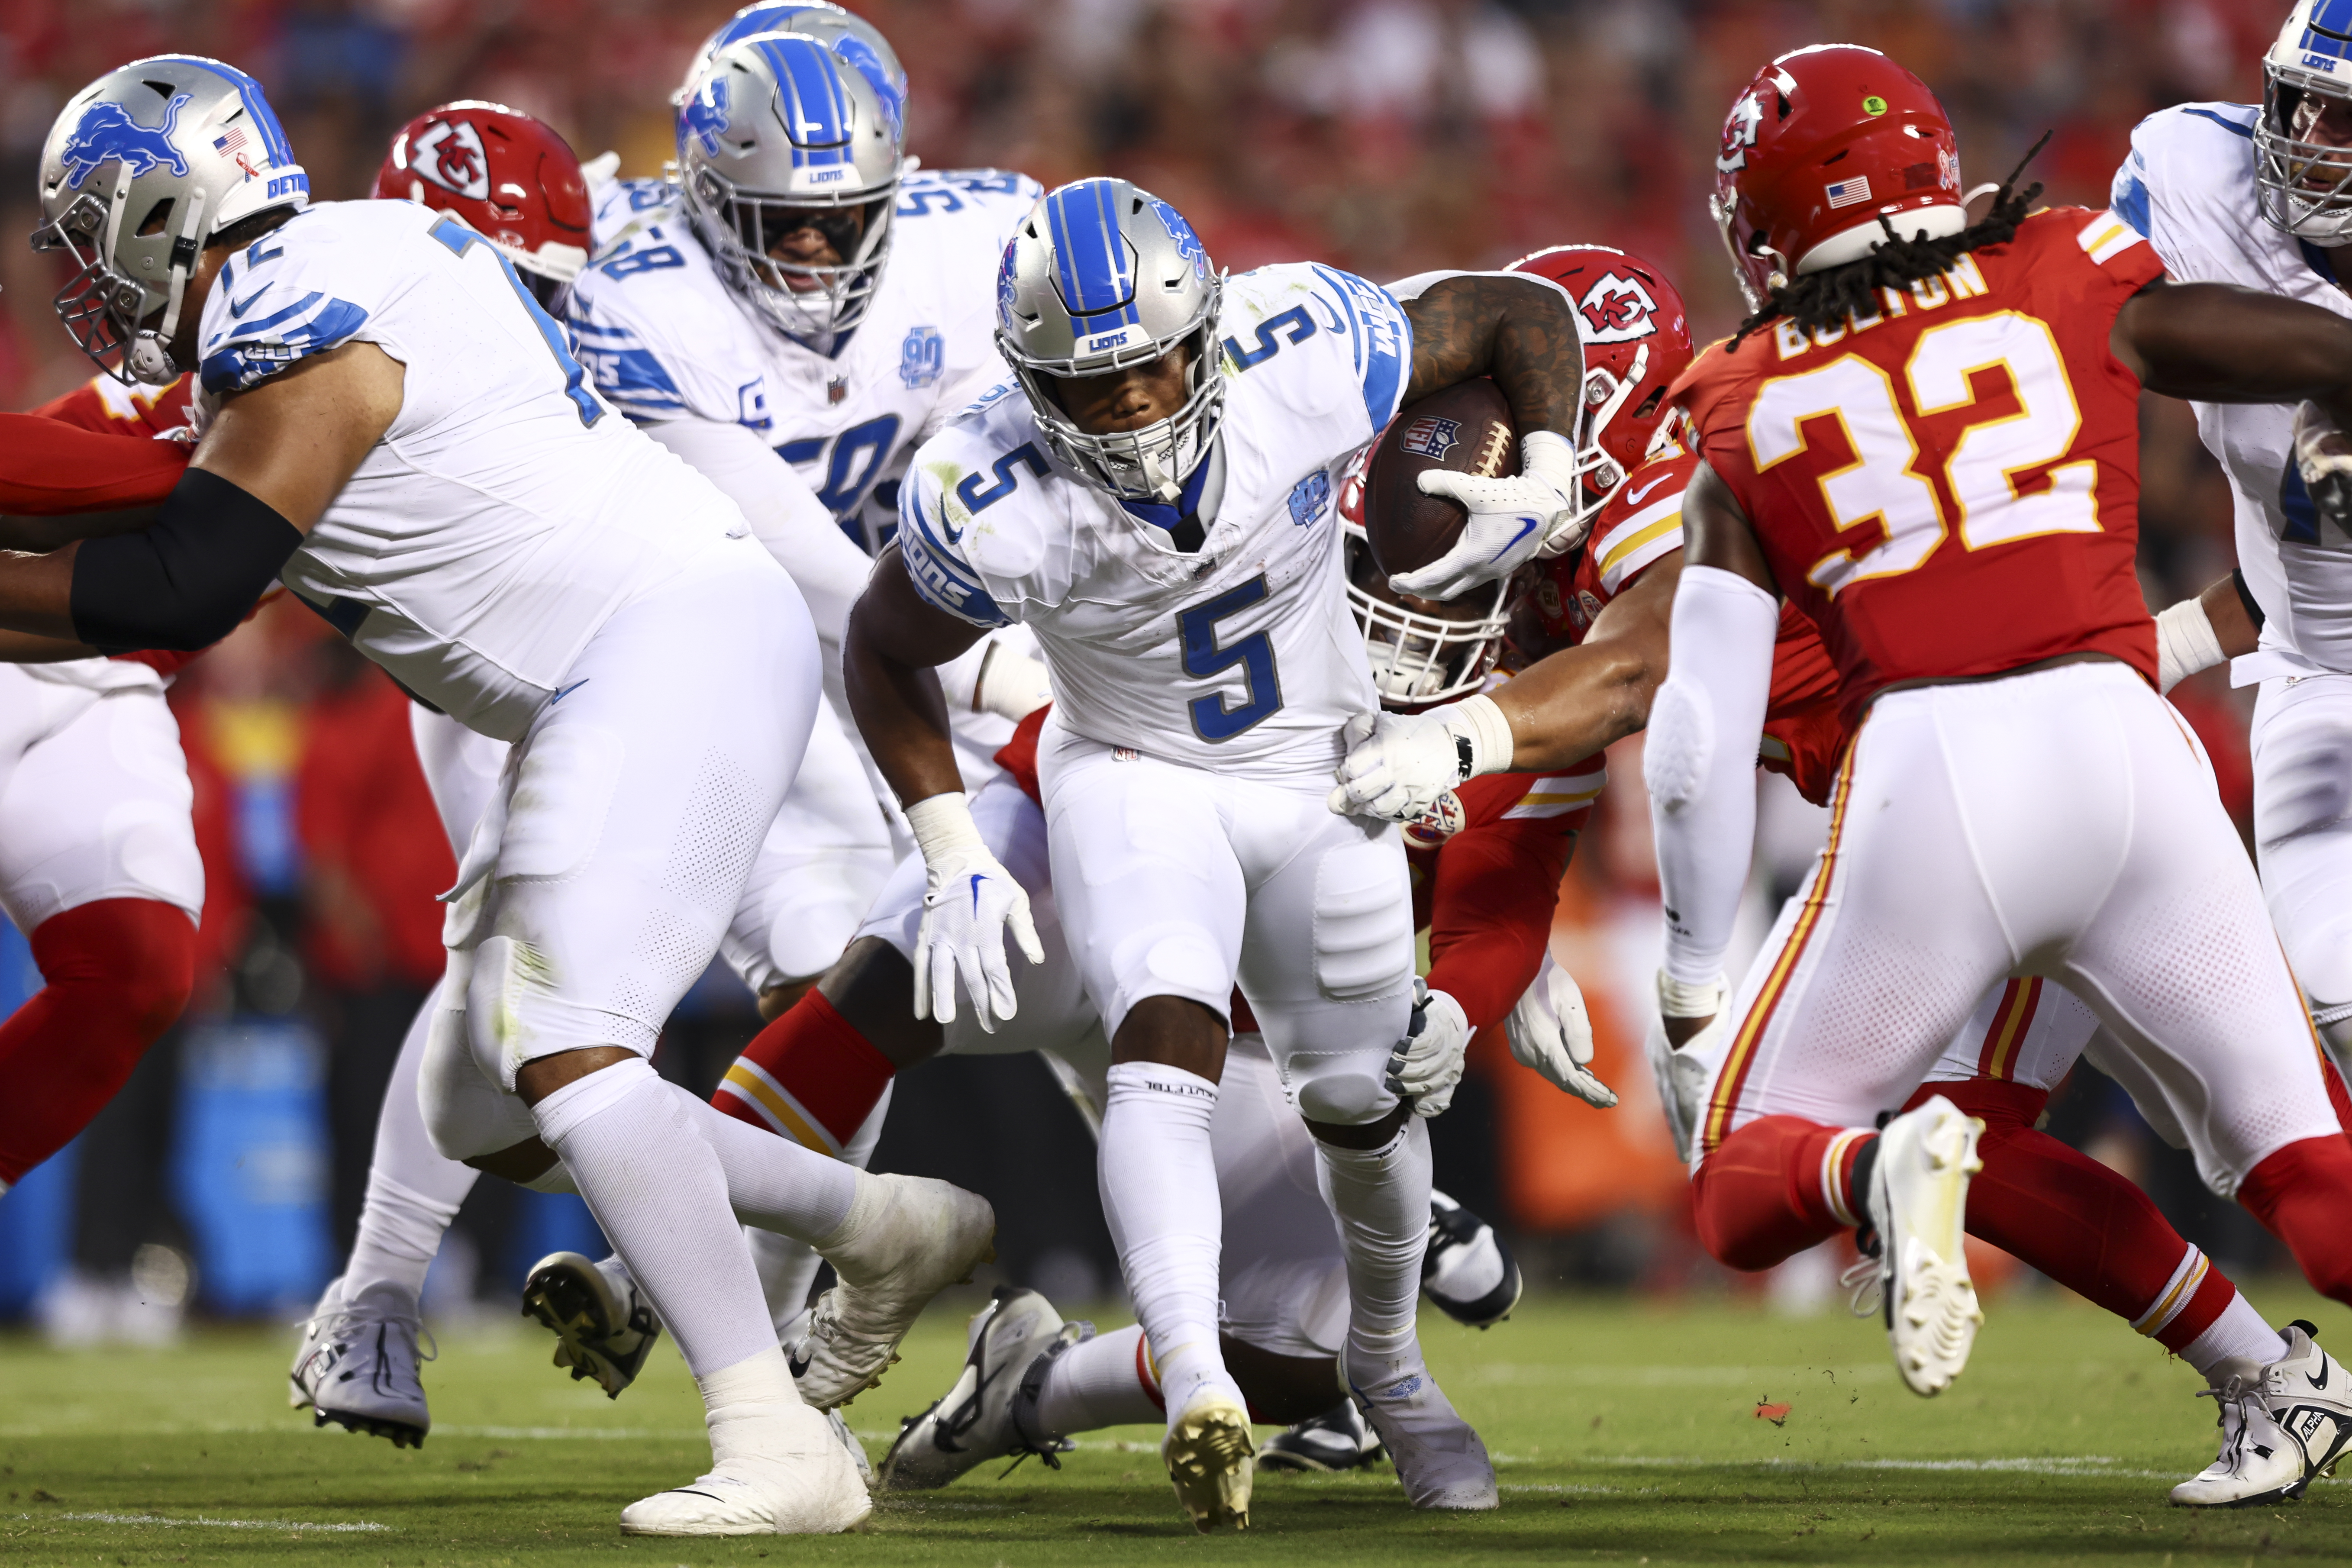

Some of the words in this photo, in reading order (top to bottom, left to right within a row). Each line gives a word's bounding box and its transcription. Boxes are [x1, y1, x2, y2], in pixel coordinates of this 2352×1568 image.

[2302, 53, 2338, 72] LIONS
[241, 162, 254, 174] 9/11
[810, 169, 844, 184] LIONS
[1579, 288, 1647, 334] KC
[1089, 331, 1128, 351] LIONS
[1222, 303, 1318, 373] 5
[1404, 418, 1439, 448] NFL
[1745, 308, 2105, 603] 32
[956, 440, 1052, 516] 5
[1175, 571, 1285, 745] 5
[1116, 747, 1137, 759] NFL
[2302, 1411, 2325, 1440] ALPHA
